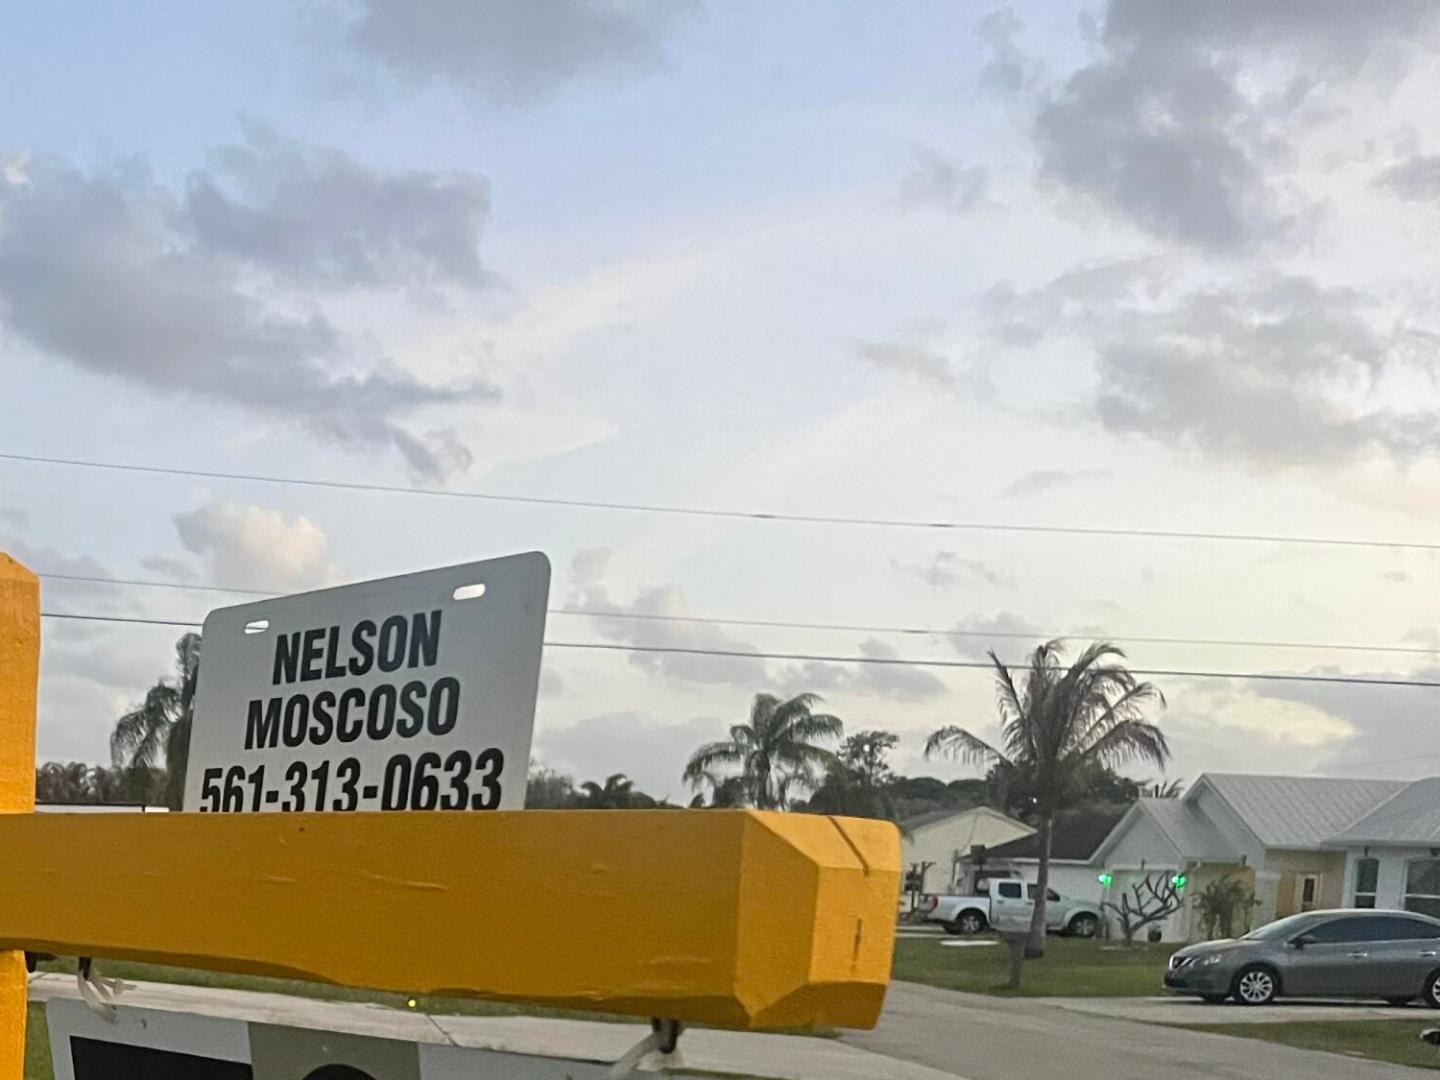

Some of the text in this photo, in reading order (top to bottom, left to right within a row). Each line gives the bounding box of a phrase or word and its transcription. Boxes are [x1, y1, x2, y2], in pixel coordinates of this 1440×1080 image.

[272, 609, 443, 685] NELSON
[244, 676, 461, 750] MOSCOSO
[199, 747, 505, 812] 561-313-0633
